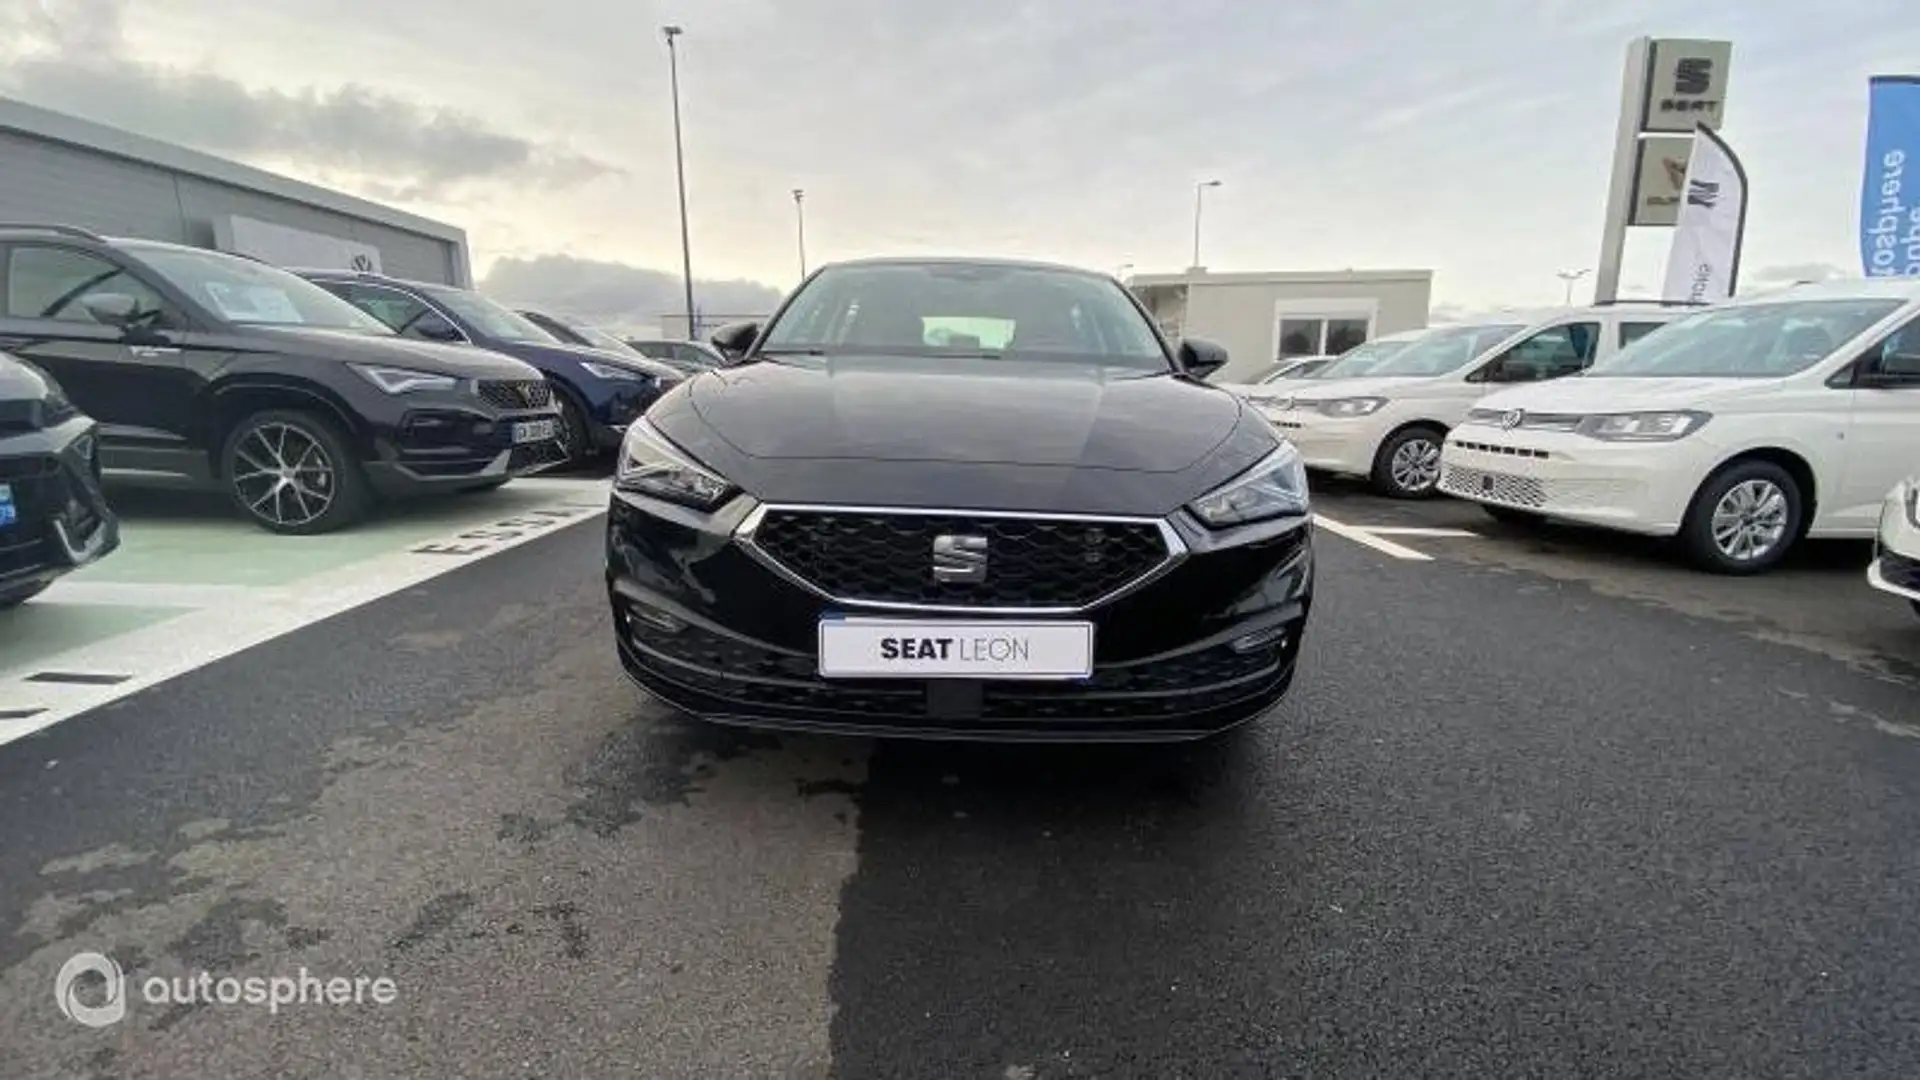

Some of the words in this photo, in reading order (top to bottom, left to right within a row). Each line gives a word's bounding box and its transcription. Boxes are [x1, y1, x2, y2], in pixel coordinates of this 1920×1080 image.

[1660, 99, 1718, 112] SEAT
[880, 638, 953, 660] SEAT
[959, 638, 1029, 662] LEON
